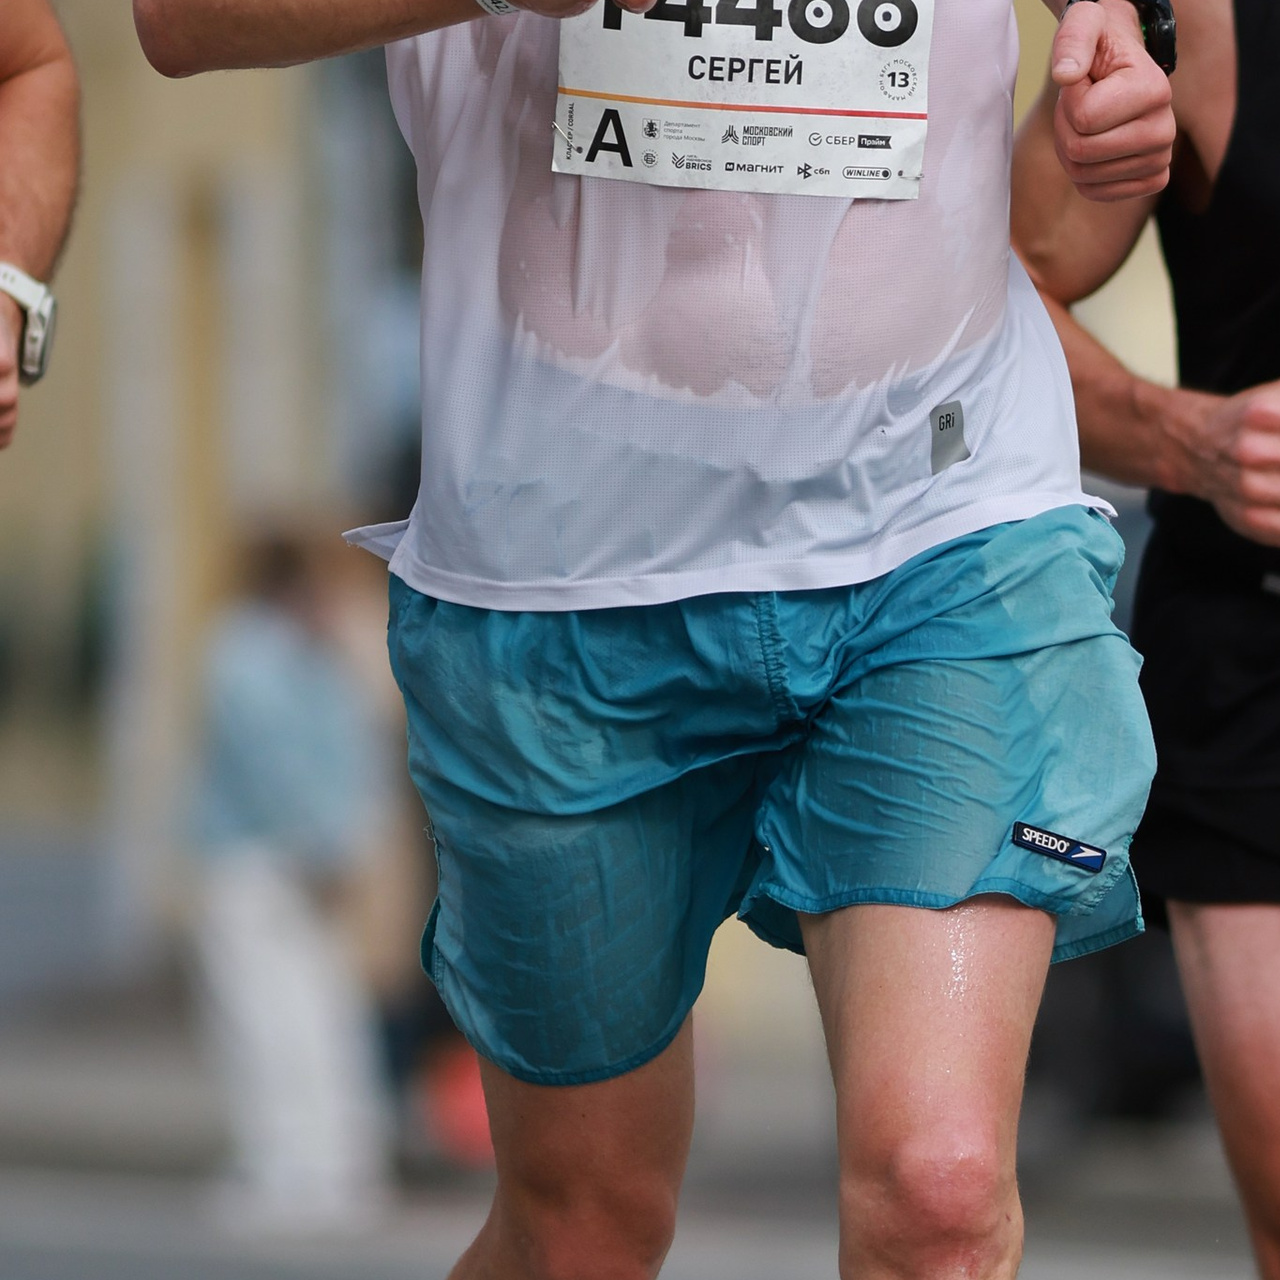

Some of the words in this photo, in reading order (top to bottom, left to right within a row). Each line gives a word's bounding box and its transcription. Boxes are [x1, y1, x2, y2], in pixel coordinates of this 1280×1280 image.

[688, 54, 803, 85] СЕРГЕЙ
[887, 72, 909, 88] 13
[742, 125, 793, 137] МОСКОВСКИЙ
[742, 136, 766, 146] СПОРТ
[825, 136, 856, 146] СБЕР
[861, 137, 886, 146] Прайм
[686, 162, 712, 171] BRICS
[846, 169, 880, 177] WINLINE
